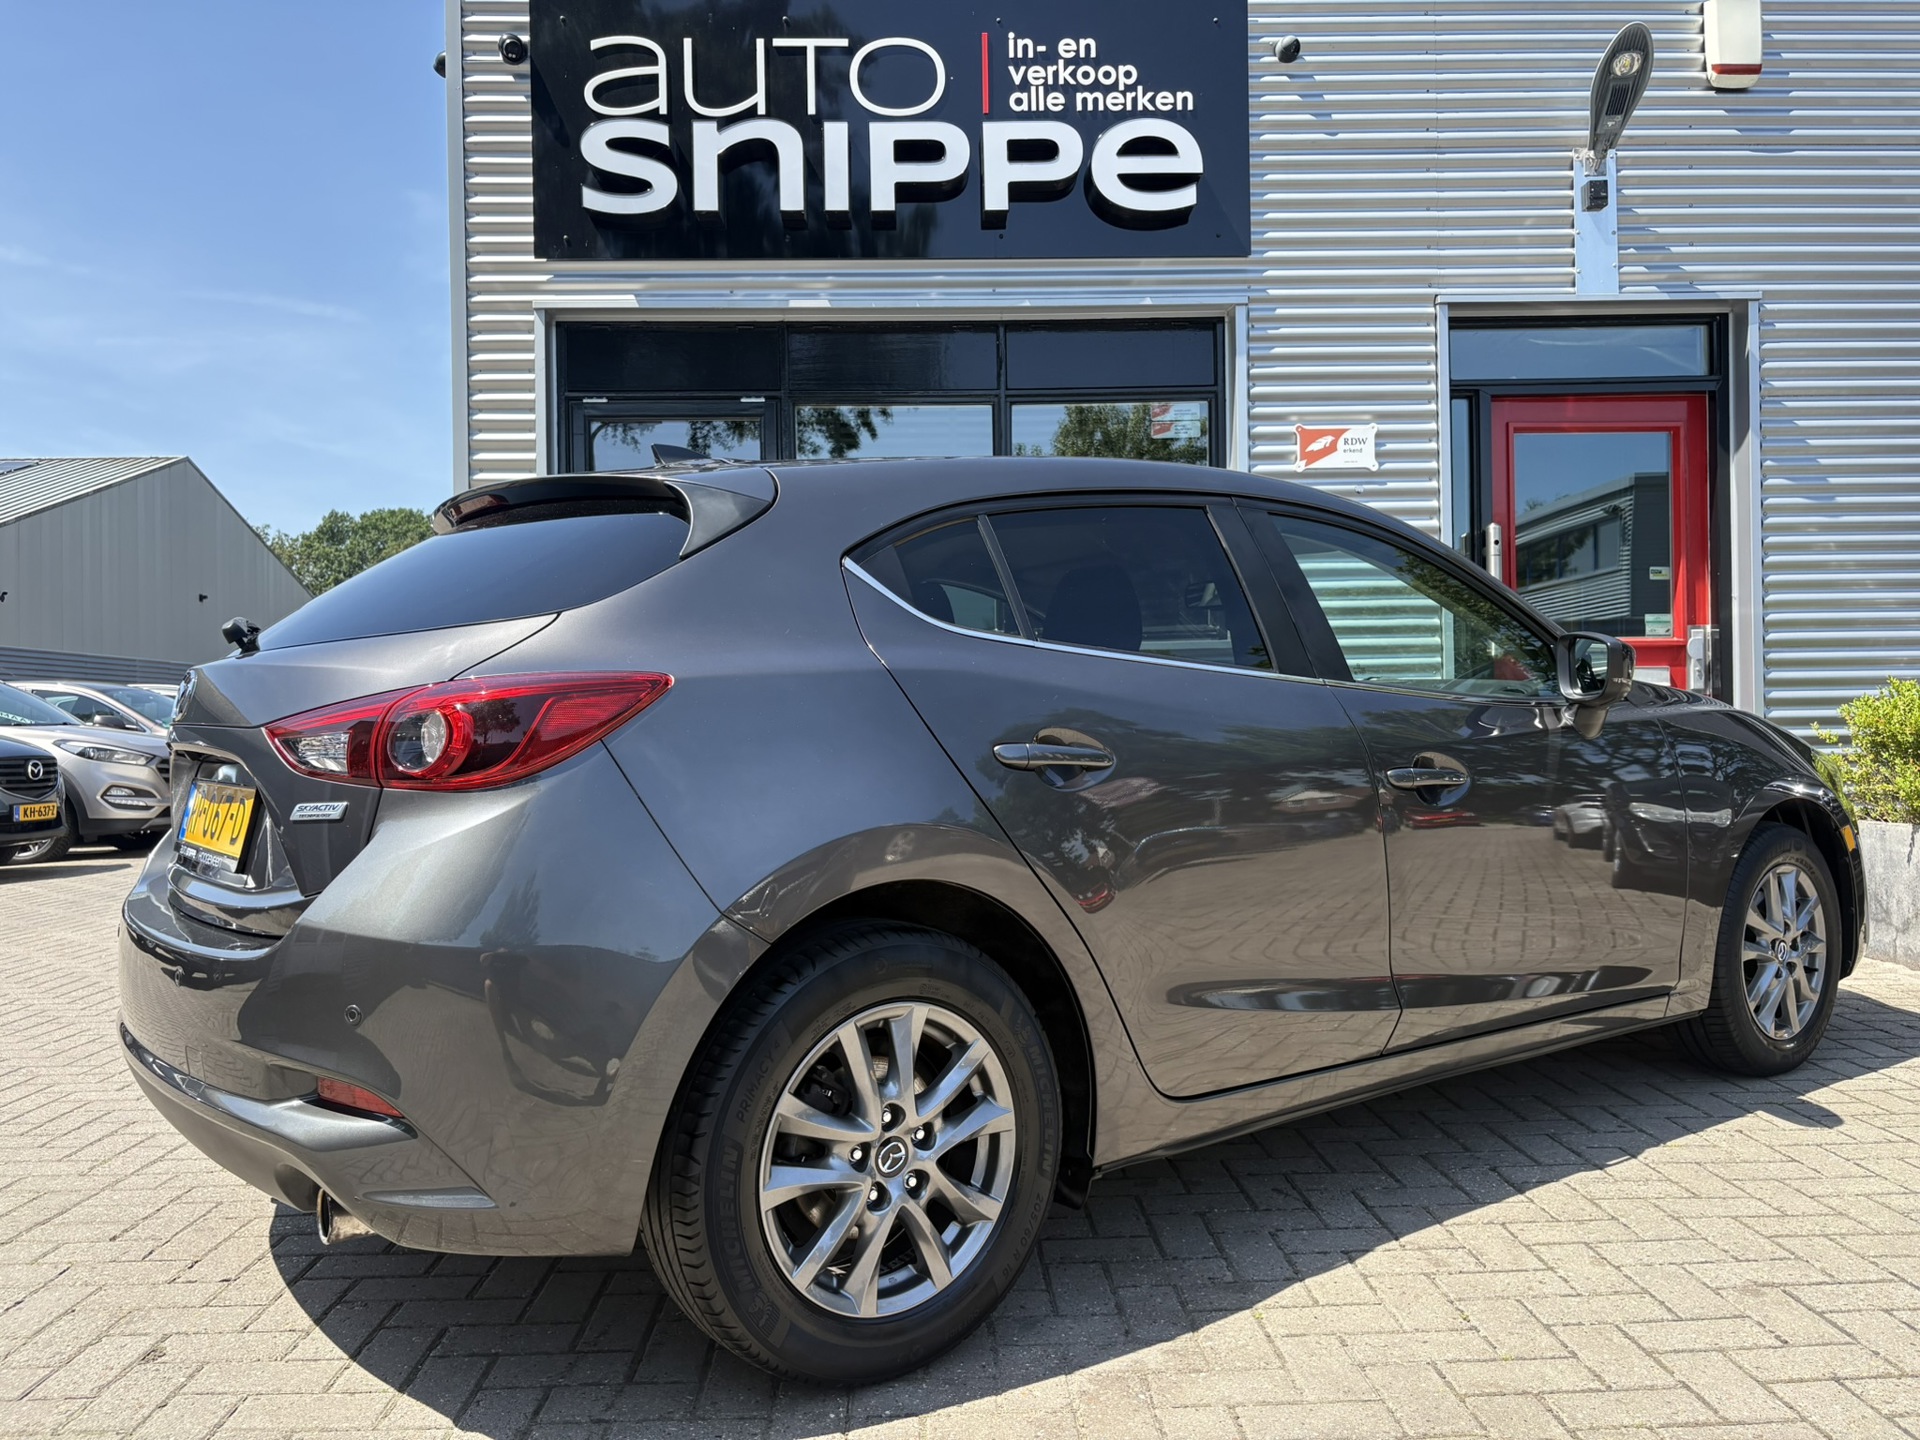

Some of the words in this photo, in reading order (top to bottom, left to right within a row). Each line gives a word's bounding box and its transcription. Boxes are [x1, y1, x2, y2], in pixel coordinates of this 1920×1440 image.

[1008, 32, 1047, 59] in-
[1058, 38, 1097, 59] en
[1008, 58, 1138, 91] verkoop
[1009, 86, 1066, 112] alle
[1076, 86, 1194, 112] merken
[1343, 437, 1368, 446] RDW
[23, 804, 56, 819] KH-637-Z
[297, 804, 340, 812] SKYACTIV
[736, 1049, 774, 1125] PRIMACY
[1029, 1044, 1056, 1175] MICHELIN
[719, 1145, 756, 1292] MICHELIN
[1021, 1192, 1044, 1247] 205/60
